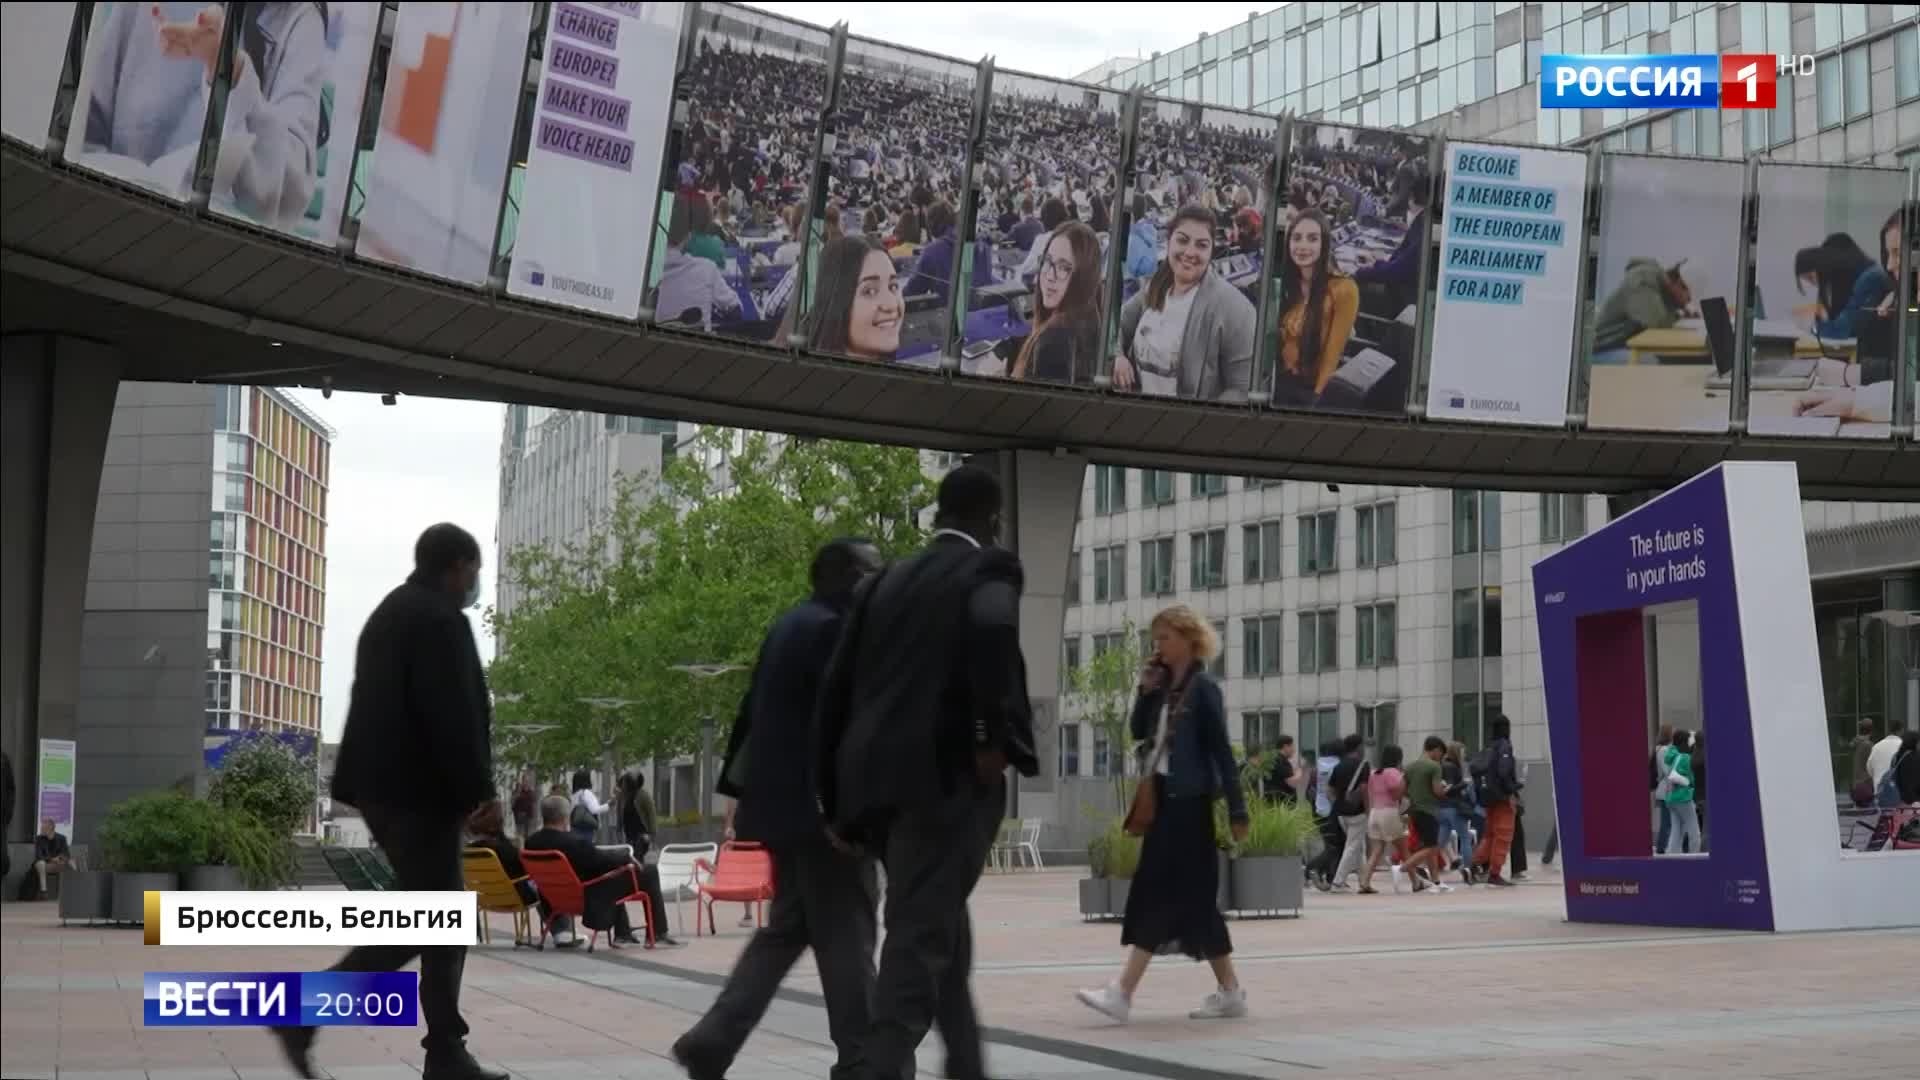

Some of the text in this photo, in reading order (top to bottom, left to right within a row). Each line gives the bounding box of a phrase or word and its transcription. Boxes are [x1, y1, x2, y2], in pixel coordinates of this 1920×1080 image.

[559, 9, 616, 42] CHANGE
[553, 48, 616, 82] EUROPE?
[547, 87, 626, 126] MAKE YOUR
[543, 124, 631, 165] VOICE HEARD
[1458, 154, 1517, 176] BECOME
[1455, 186, 1553, 209] A MEMBER OF
[1453, 216, 1561, 241] THE EUROPEAN
[1451, 248, 1544, 272] PARLIAMENT
[1448, 279, 1521, 300] FOR A DAY
[1629, 523, 1705, 558] The future is
[1626, 554, 1706, 594] in your hands
